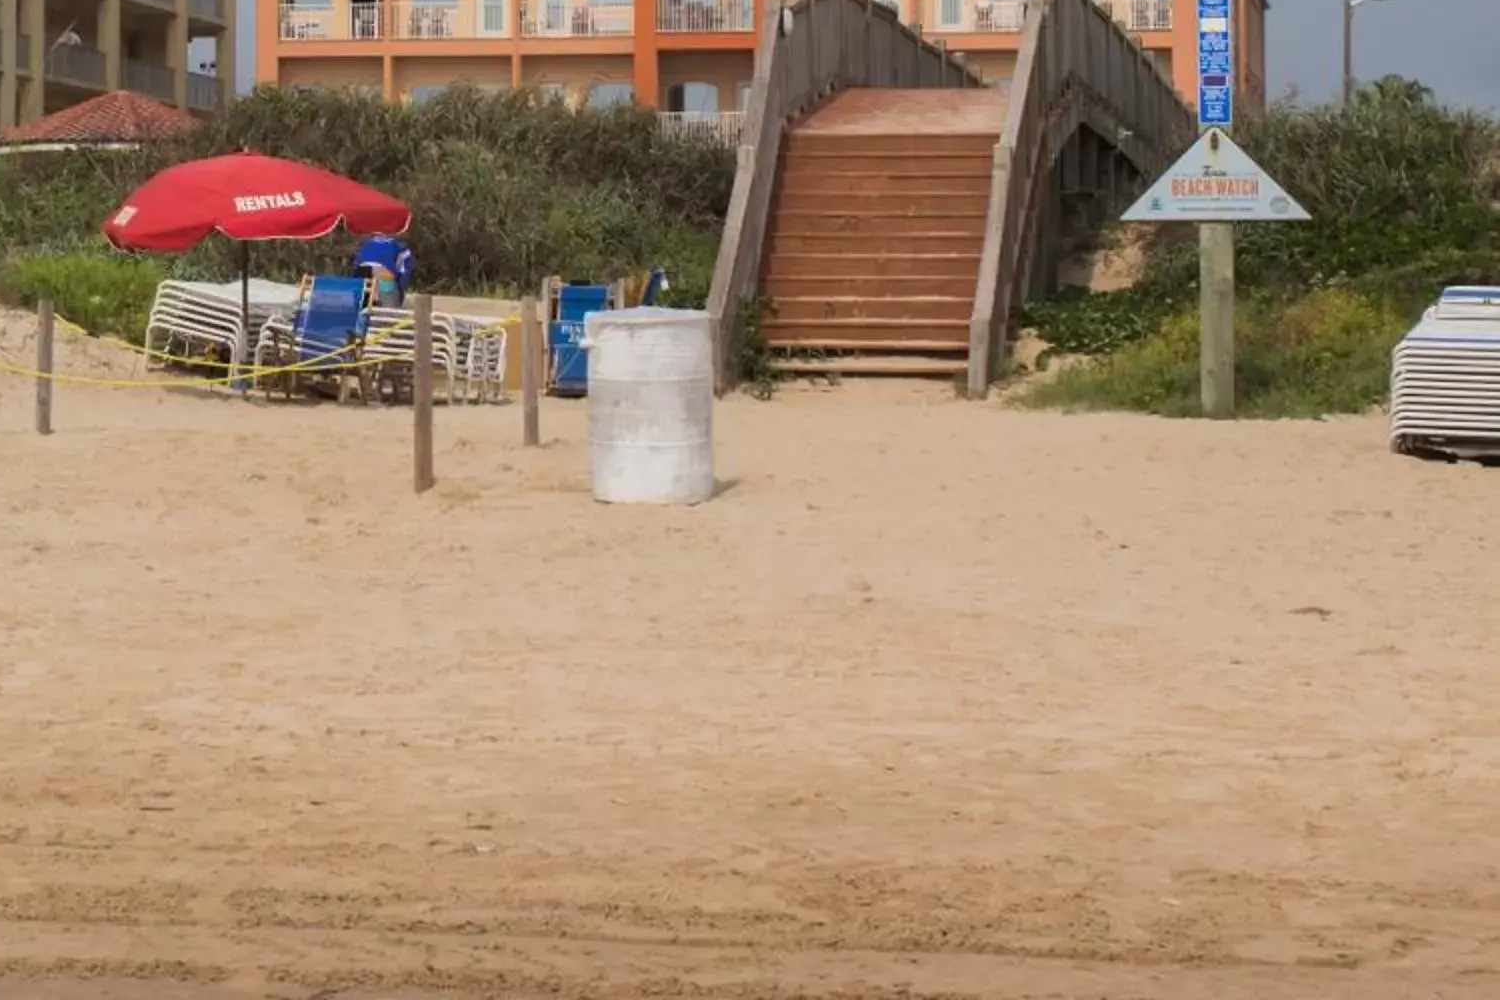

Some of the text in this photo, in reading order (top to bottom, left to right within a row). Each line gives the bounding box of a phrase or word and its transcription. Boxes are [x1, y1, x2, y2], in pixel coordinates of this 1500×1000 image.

[1171, 178, 1259, 197] BEACH WATCH
[233, 191, 305, 213] RENTALS
